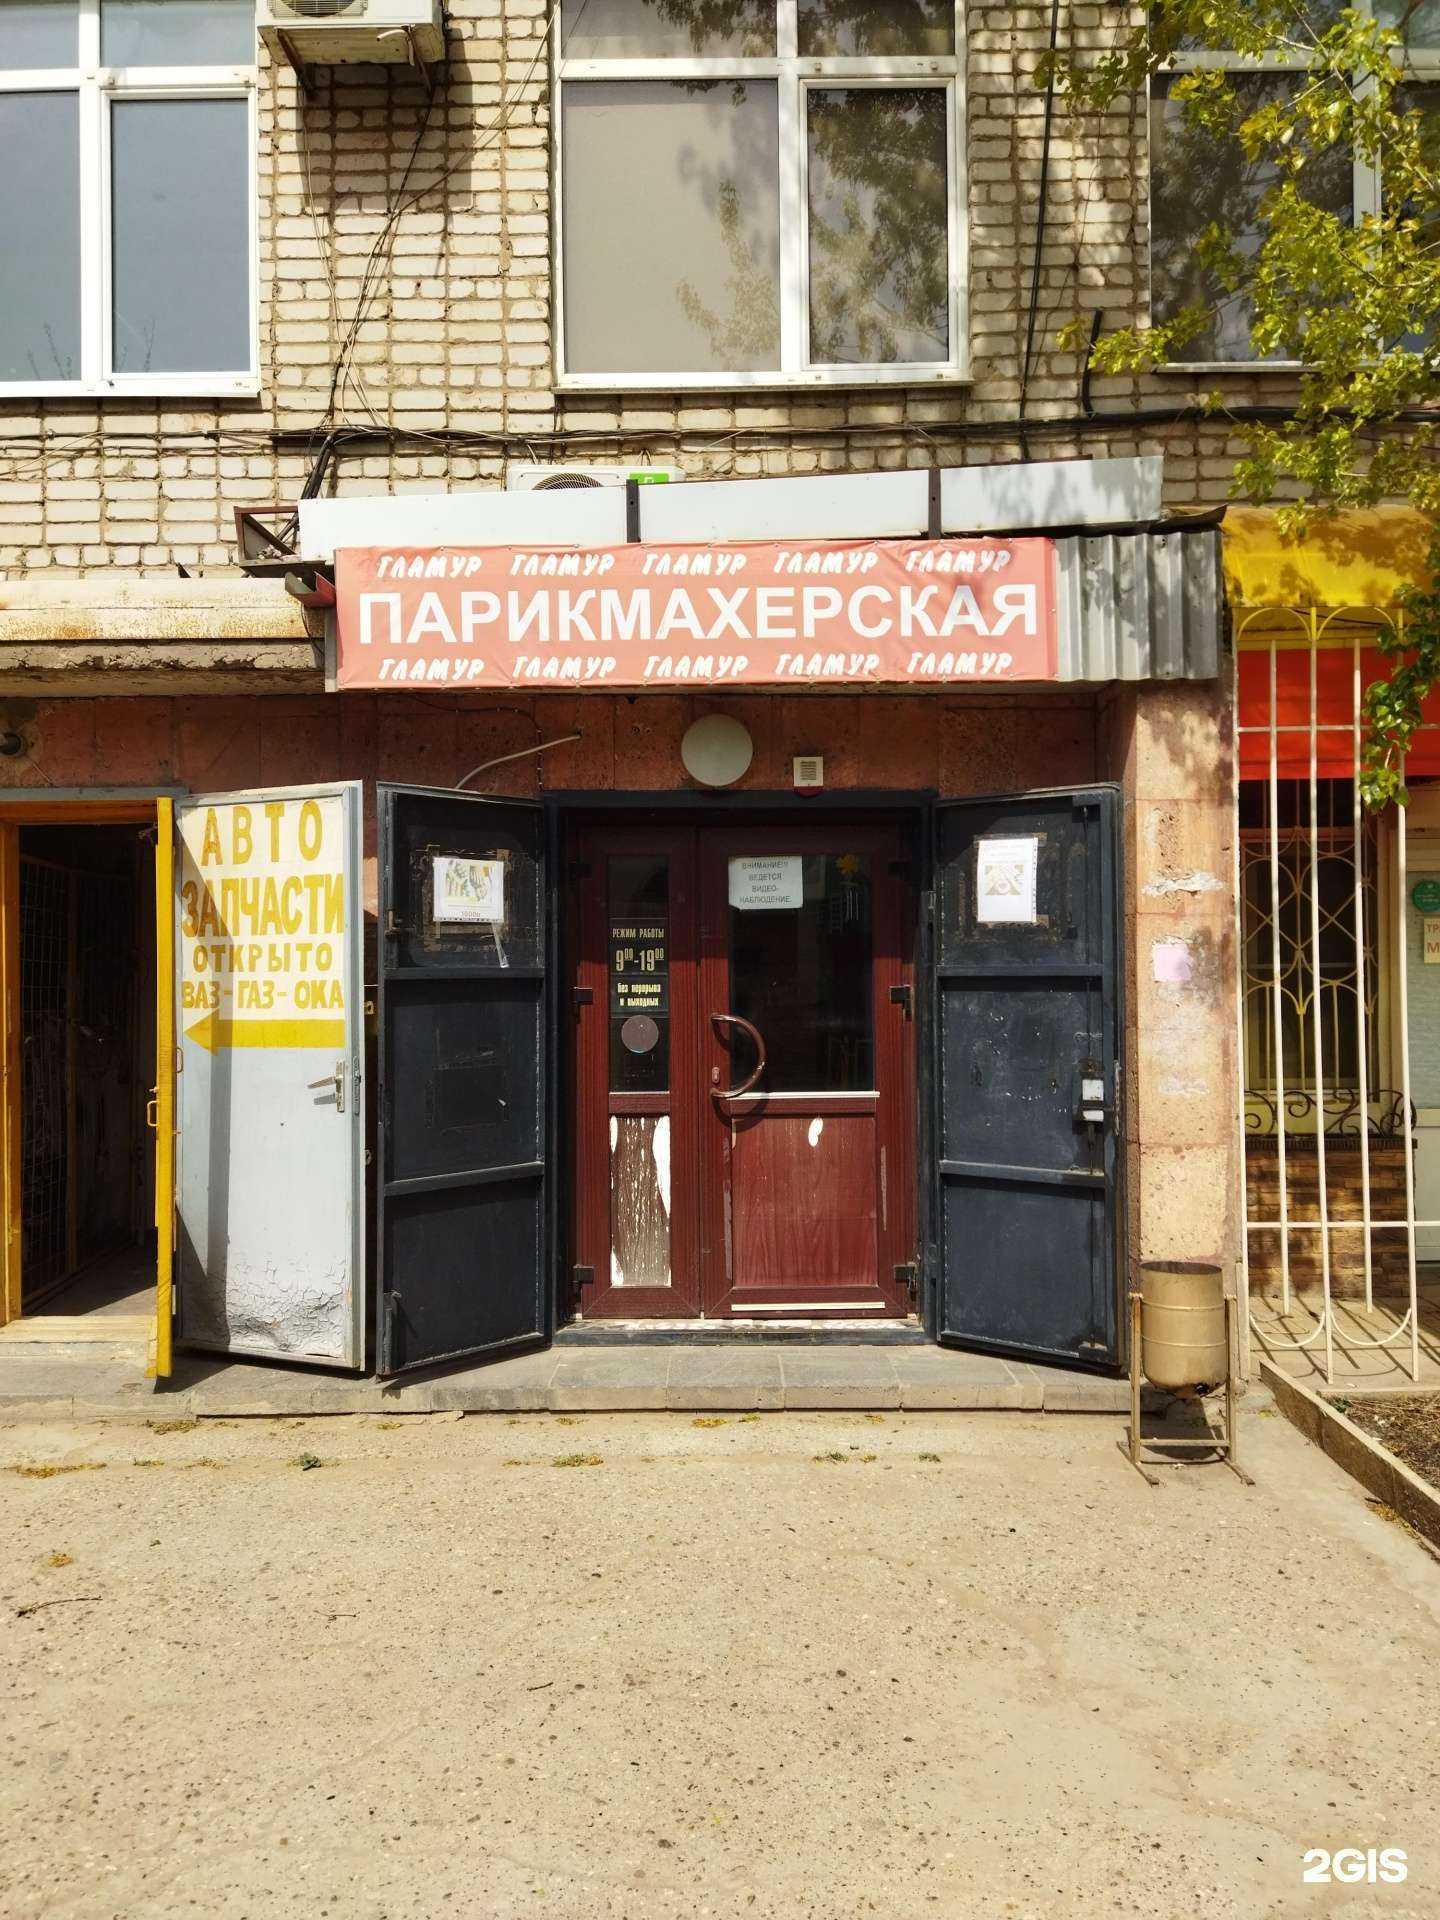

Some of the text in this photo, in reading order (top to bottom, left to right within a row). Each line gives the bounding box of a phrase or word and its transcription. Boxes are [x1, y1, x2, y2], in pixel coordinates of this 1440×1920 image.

[377, 550, 1011, 578] ГЛАМУР ГЛАМУР ГЛАМУР ГЛАМУР ГЛАМУР
[359, 584, 1037, 644] ПАРИКМАХЕРСКАЯ
[378, 652, 1013, 680] ГЛАМУР ГЛАМУР ГЛАМУР ГЛАМУР ГЛАМУР
[201, 800, 323, 866] АВТО
[182, 873, 345, 937] ЗАПЧАСТИ
[612, 928, 665, 938] РЕЖИМ РАБОТЫ
[193, 943, 332, 973] ОТКРЫТО
[617, 983, 629, 993] без
